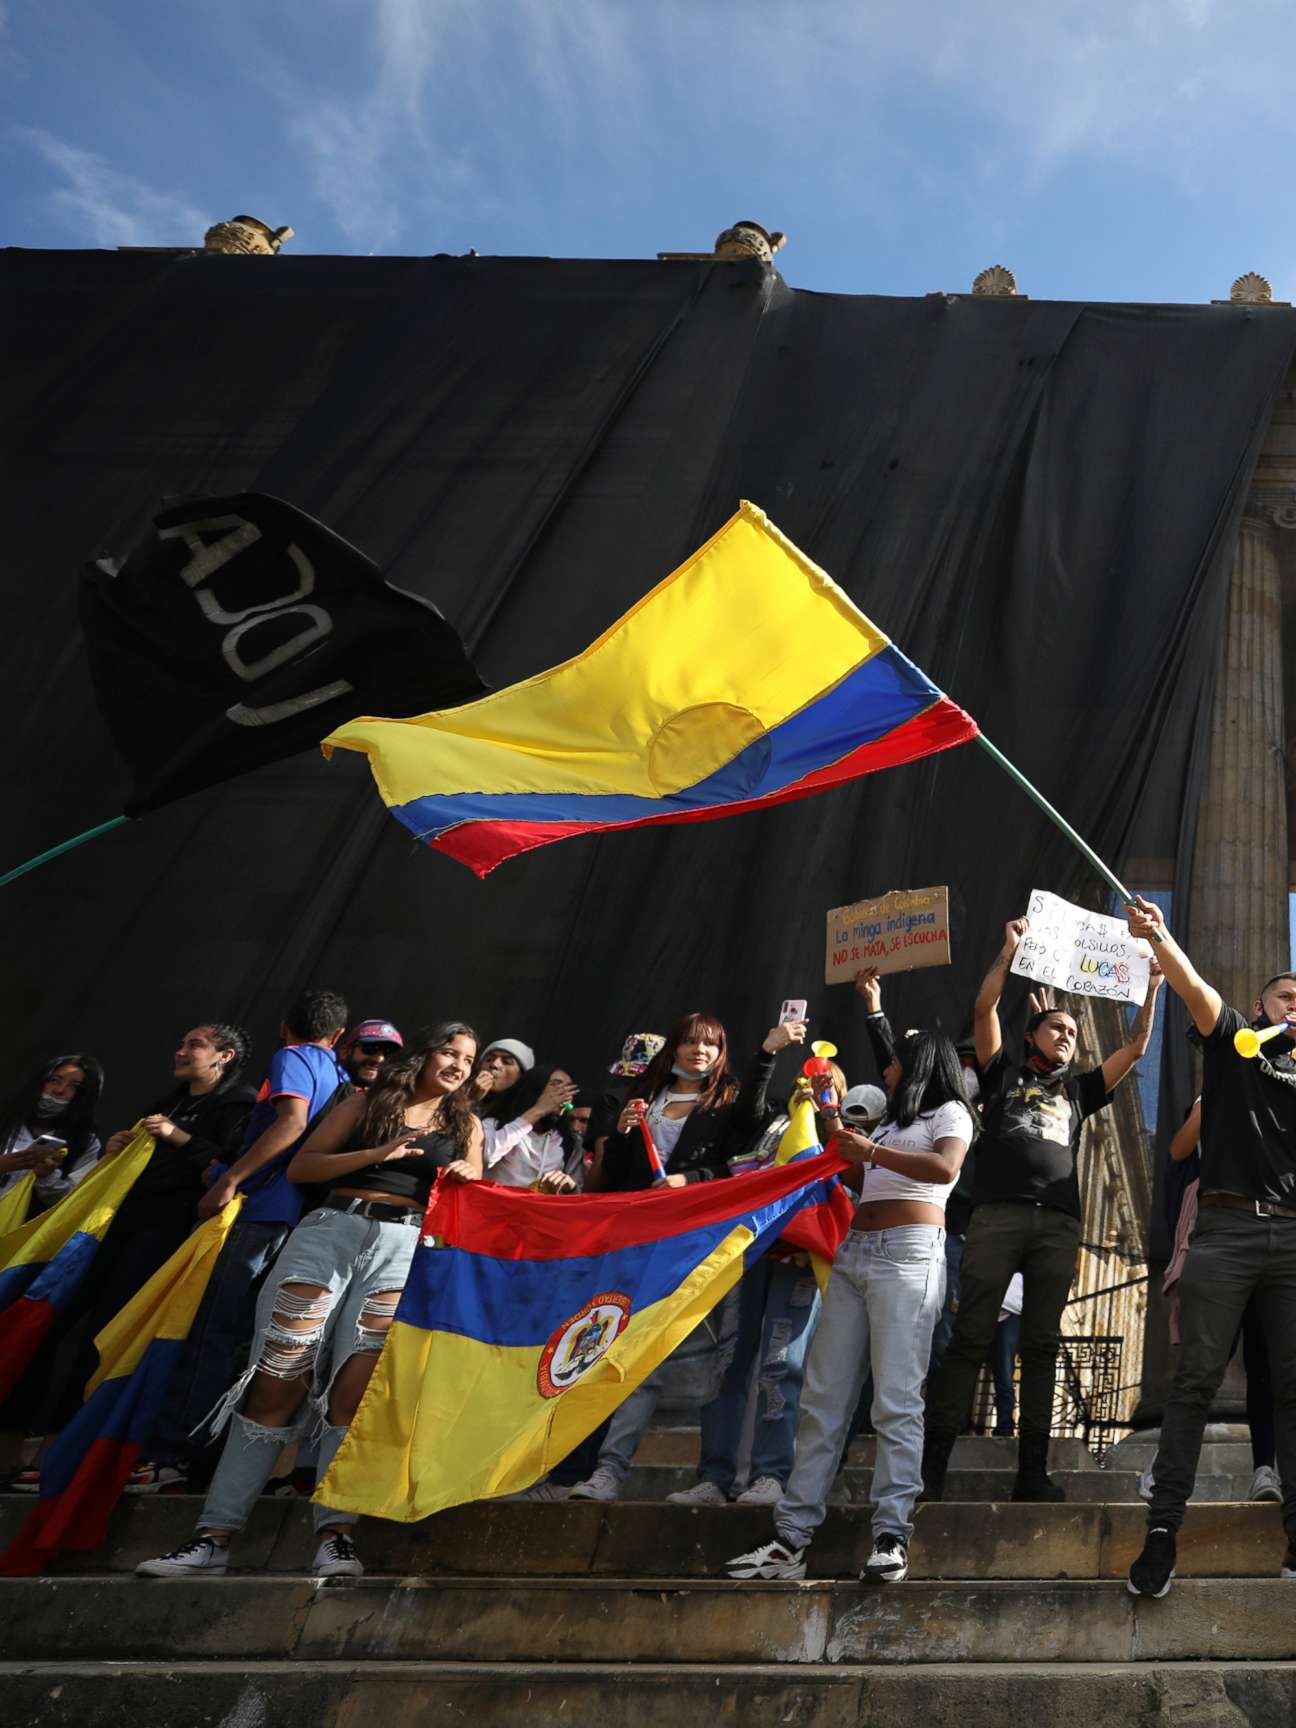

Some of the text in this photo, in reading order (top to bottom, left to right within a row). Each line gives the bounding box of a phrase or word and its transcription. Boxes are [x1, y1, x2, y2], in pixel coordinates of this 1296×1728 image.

[835, 930, 849, 944] La
[853, 923, 881, 945] minga
[832, 929, 949, 966] NO SE MATA, SE ESCUCHA
[1019, 957, 1036, 972] EN
[1042, 966, 1056, 979] EL
